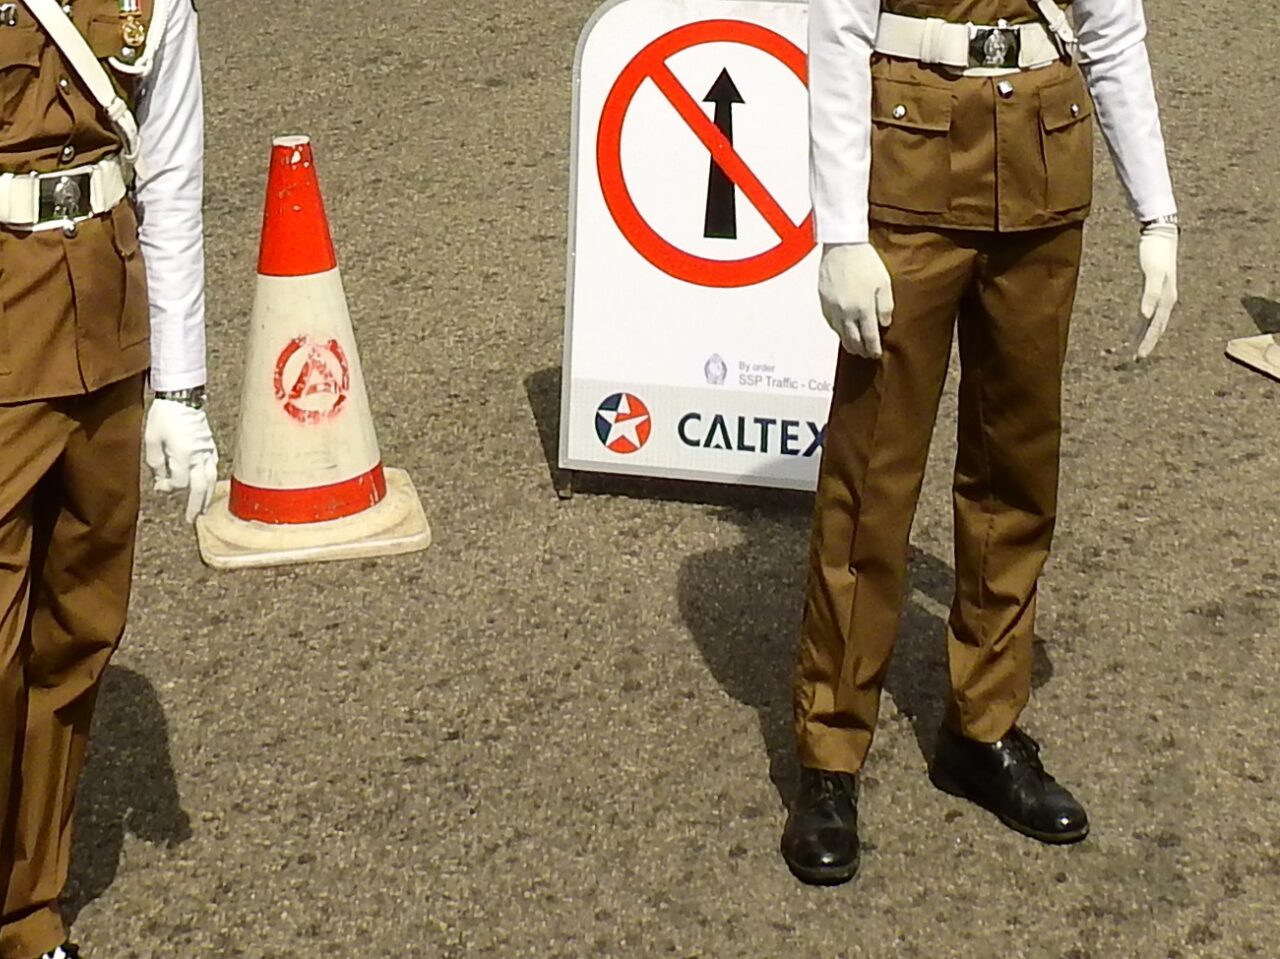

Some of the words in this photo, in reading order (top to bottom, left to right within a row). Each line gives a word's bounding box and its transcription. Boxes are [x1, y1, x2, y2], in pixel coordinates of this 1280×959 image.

[752, 362, 775, 373] order
[738, 374, 762, 387] SSP
[766, 376, 798, 390] Traffic
[808, 379, 832, 392] Colo
[677, 412, 830, 457] CALTEX
